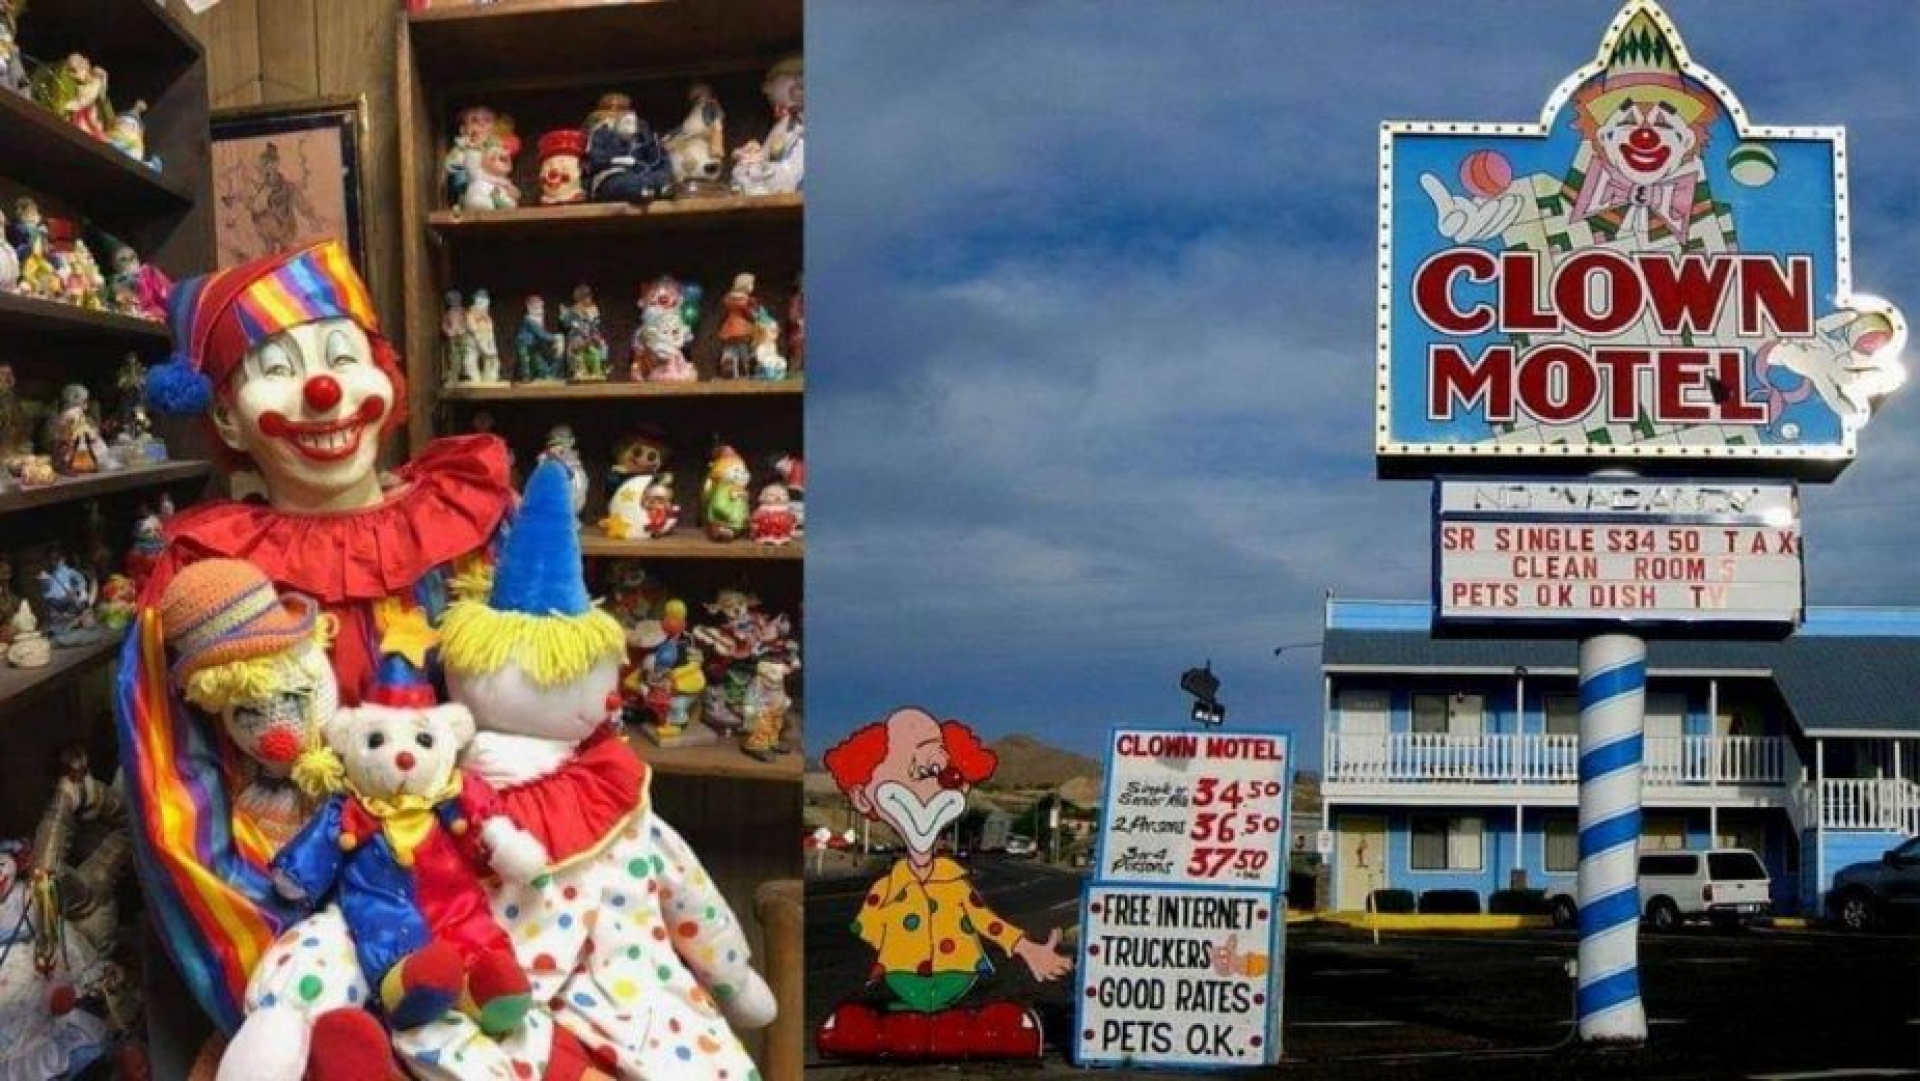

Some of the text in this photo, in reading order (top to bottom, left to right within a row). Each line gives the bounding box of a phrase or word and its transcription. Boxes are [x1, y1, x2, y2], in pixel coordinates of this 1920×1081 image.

[1413, 247, 1813, 336] CLOWN
[1429, 344, 1770, 423] MOTEL
[1443, 528, 1476, 551] SR
[1495, 528, 1595, 552] SINGLE
[1513, 556, 1598, 580] CLEAN
[1452, 583, 1519, 607] PETS
[1537, 584, 1574, 608] OK
[1589, 584, 1656, 608] DISH
[1116, 734, 1283, 761] CLOWN MOTEL
[1102, 894, 1259, 930] FREE INTERNET
[1101, 935, 1213, 969] TRUCKERS
[1099, 977, 1251, 1014] GOOD RATES
[1102, 1019, 1172, 1053] PETS
